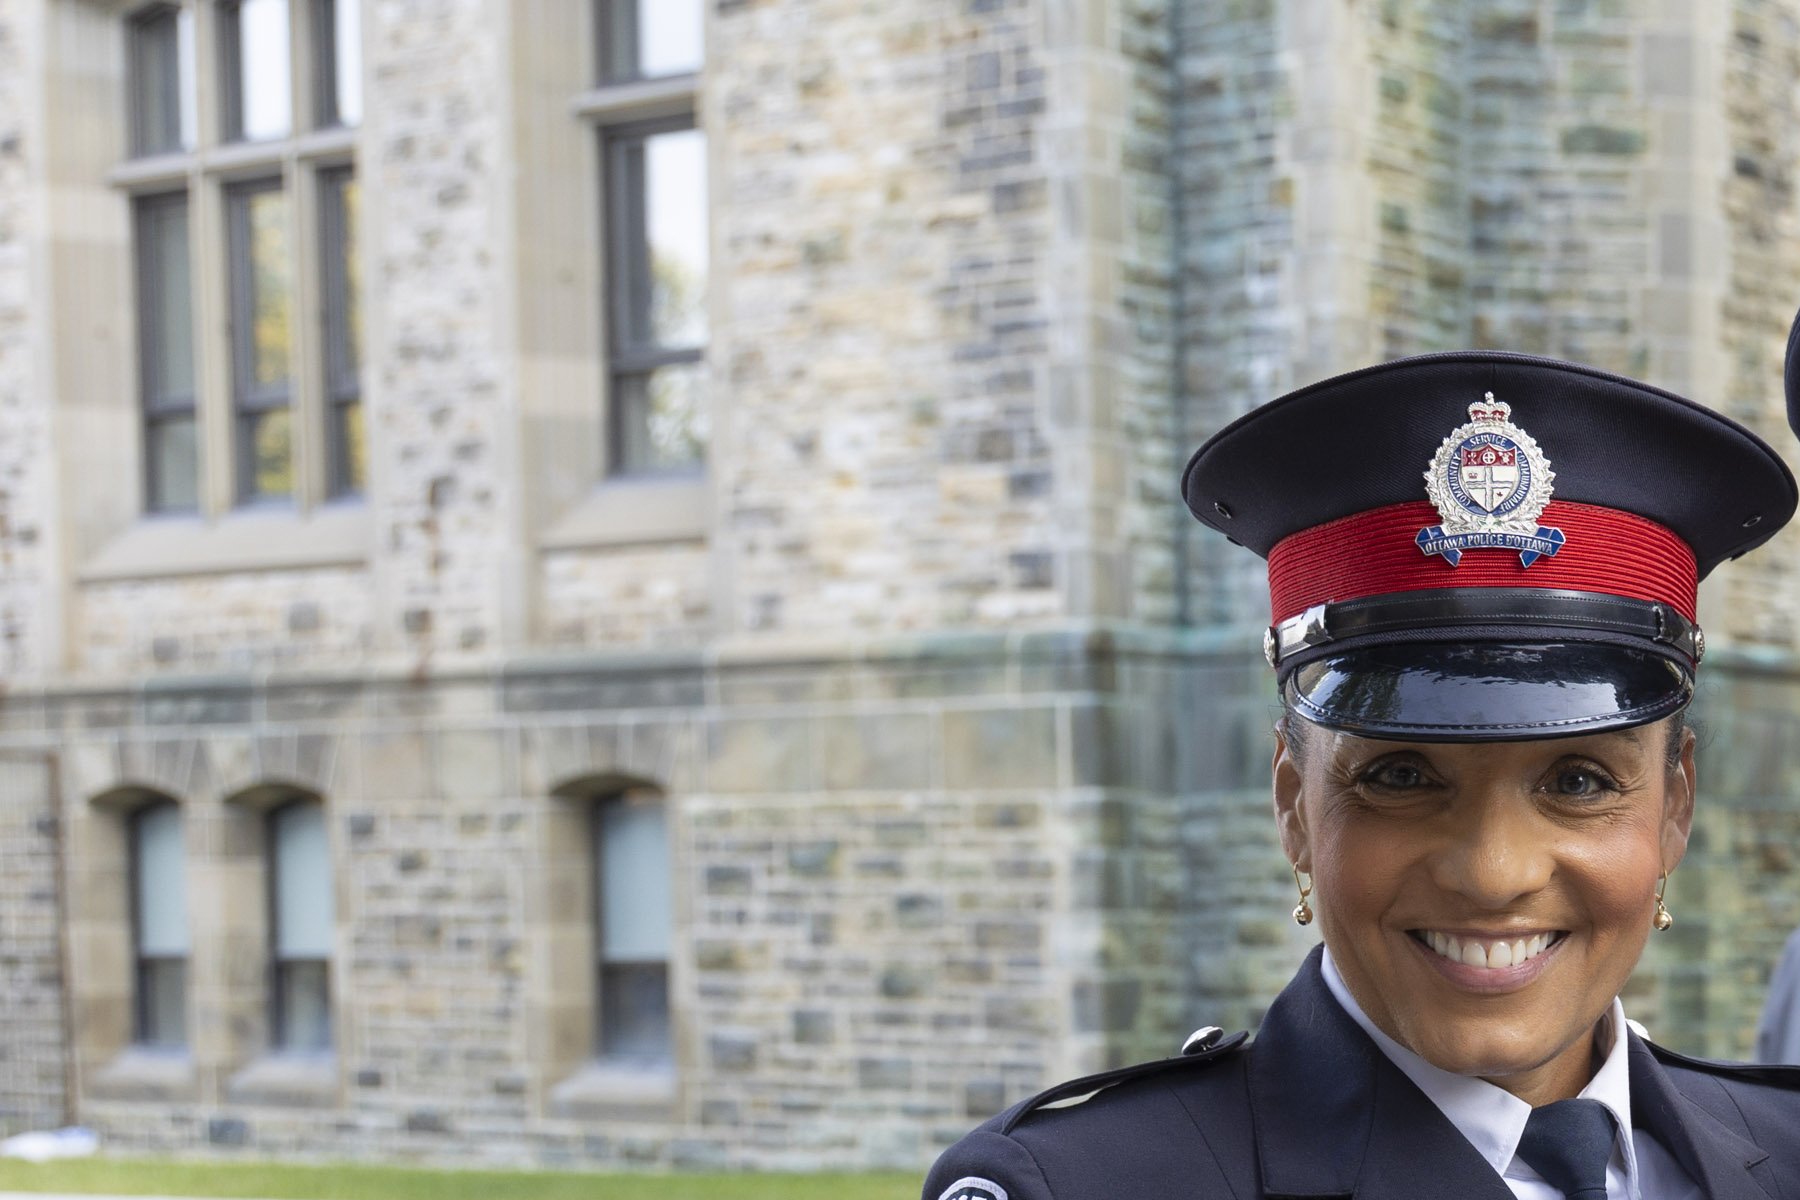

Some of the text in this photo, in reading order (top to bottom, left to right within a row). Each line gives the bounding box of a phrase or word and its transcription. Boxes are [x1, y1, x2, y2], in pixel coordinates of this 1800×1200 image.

[1449, 452, 1472, 507] COMMUNITY
[1469, 434, 1507, 447] SERVICE
[1425, 533, 1553, 554] OTTAWA POLICE D'OTTAWA
